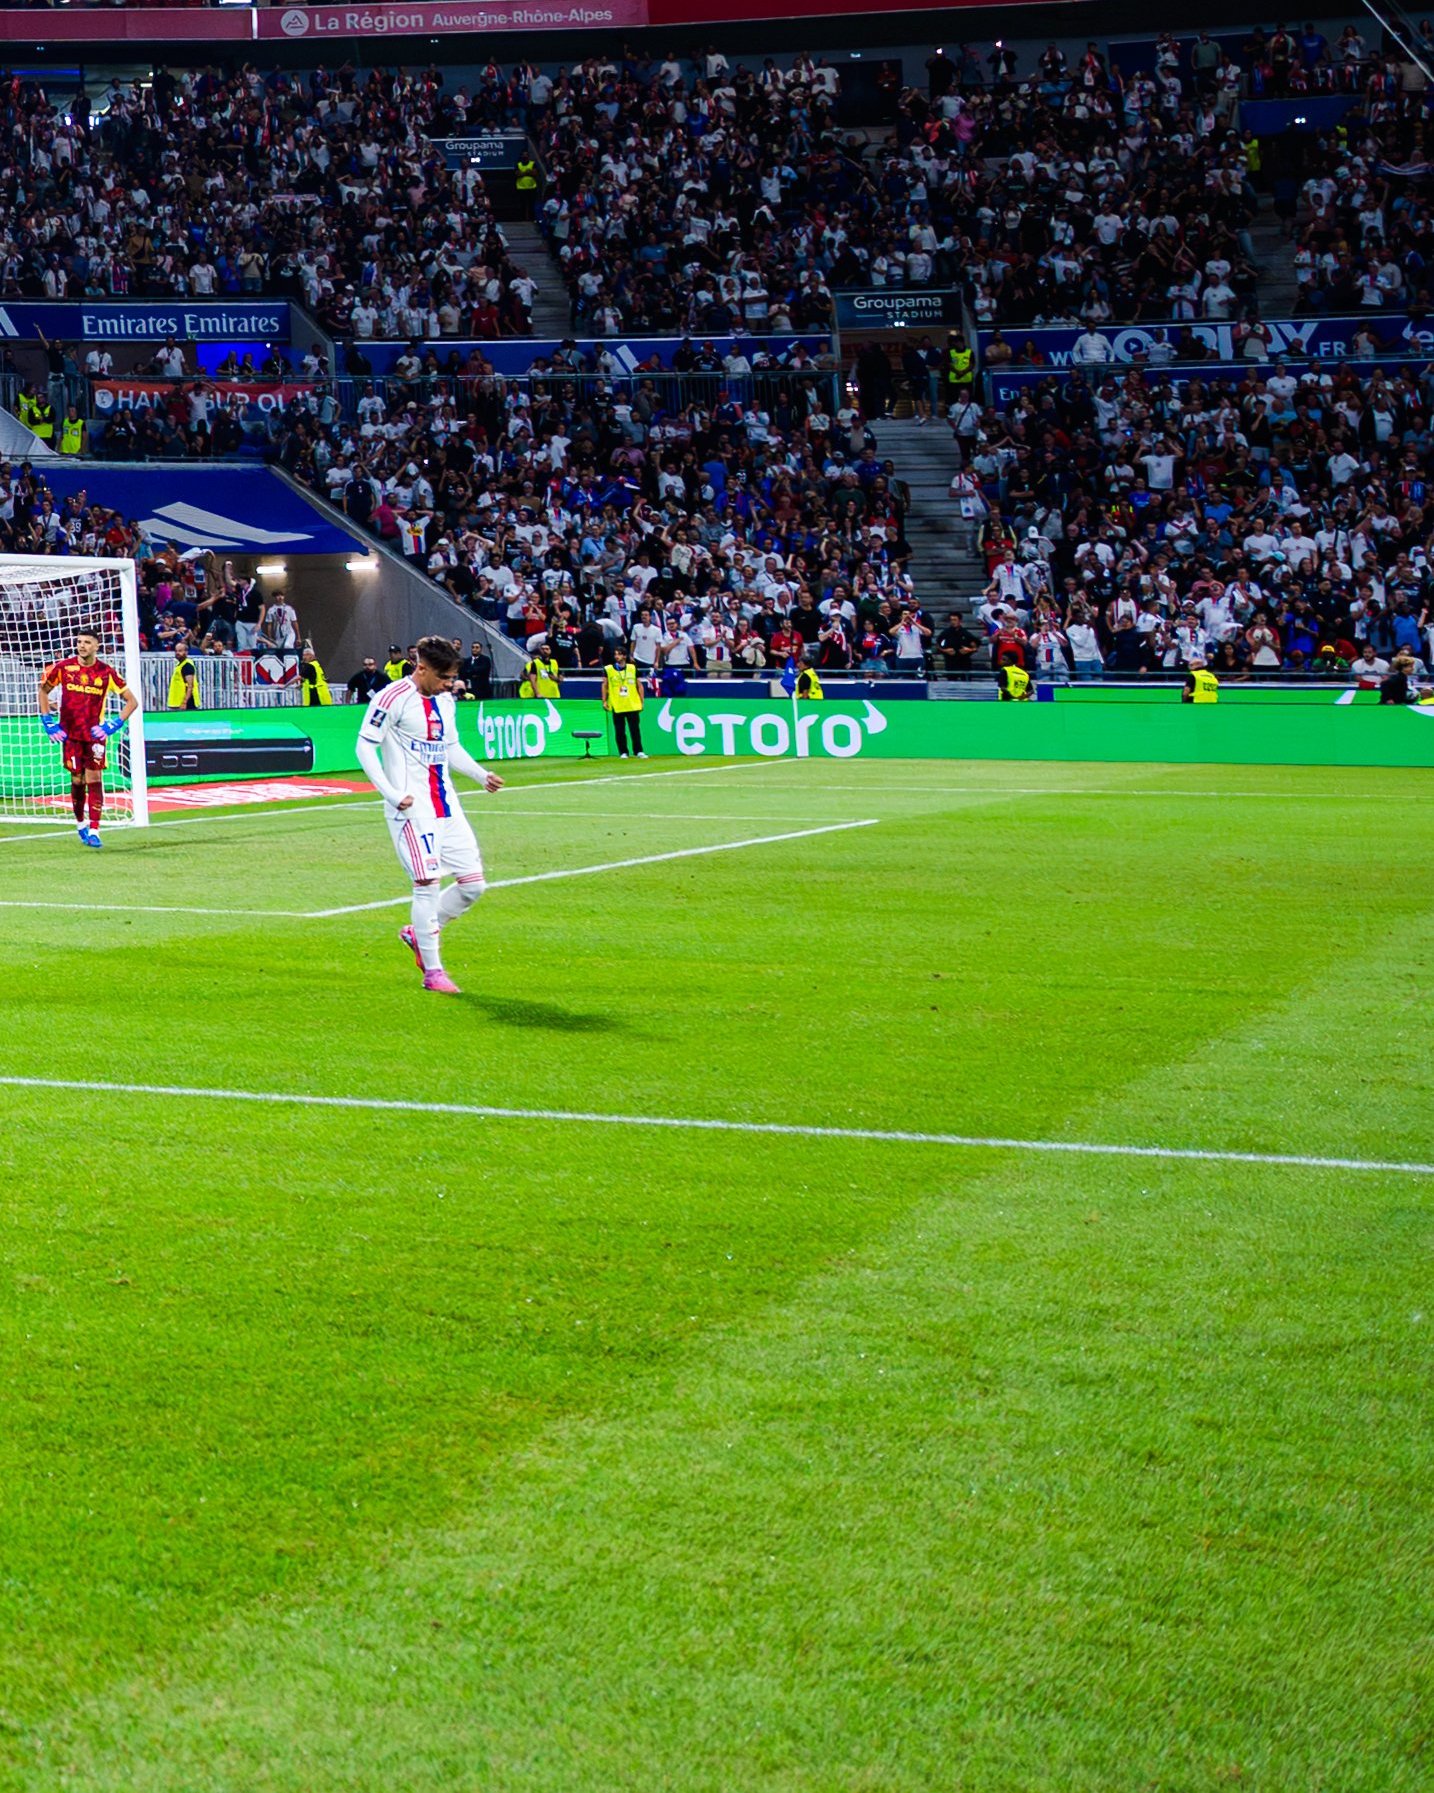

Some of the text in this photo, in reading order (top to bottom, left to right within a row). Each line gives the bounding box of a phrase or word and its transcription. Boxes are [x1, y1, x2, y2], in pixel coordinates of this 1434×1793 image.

[314, 5, 614, 36] La Région Auvergne-Rhône-Alpes
[444, 140, 505, 154] Groupama
[853, 295, 943, 310] Groupama
[82, 312, 280, 336] Emirates Emirates
[886, 310, 944, 320] STADIUM
[66, 683, 85, 694] CMA
[484, 713, 545, 760] eToro
[675, 711, 863, 758] eToro
[70, 756, 77, 770] 1
[420, 832, 435, 855] 17
